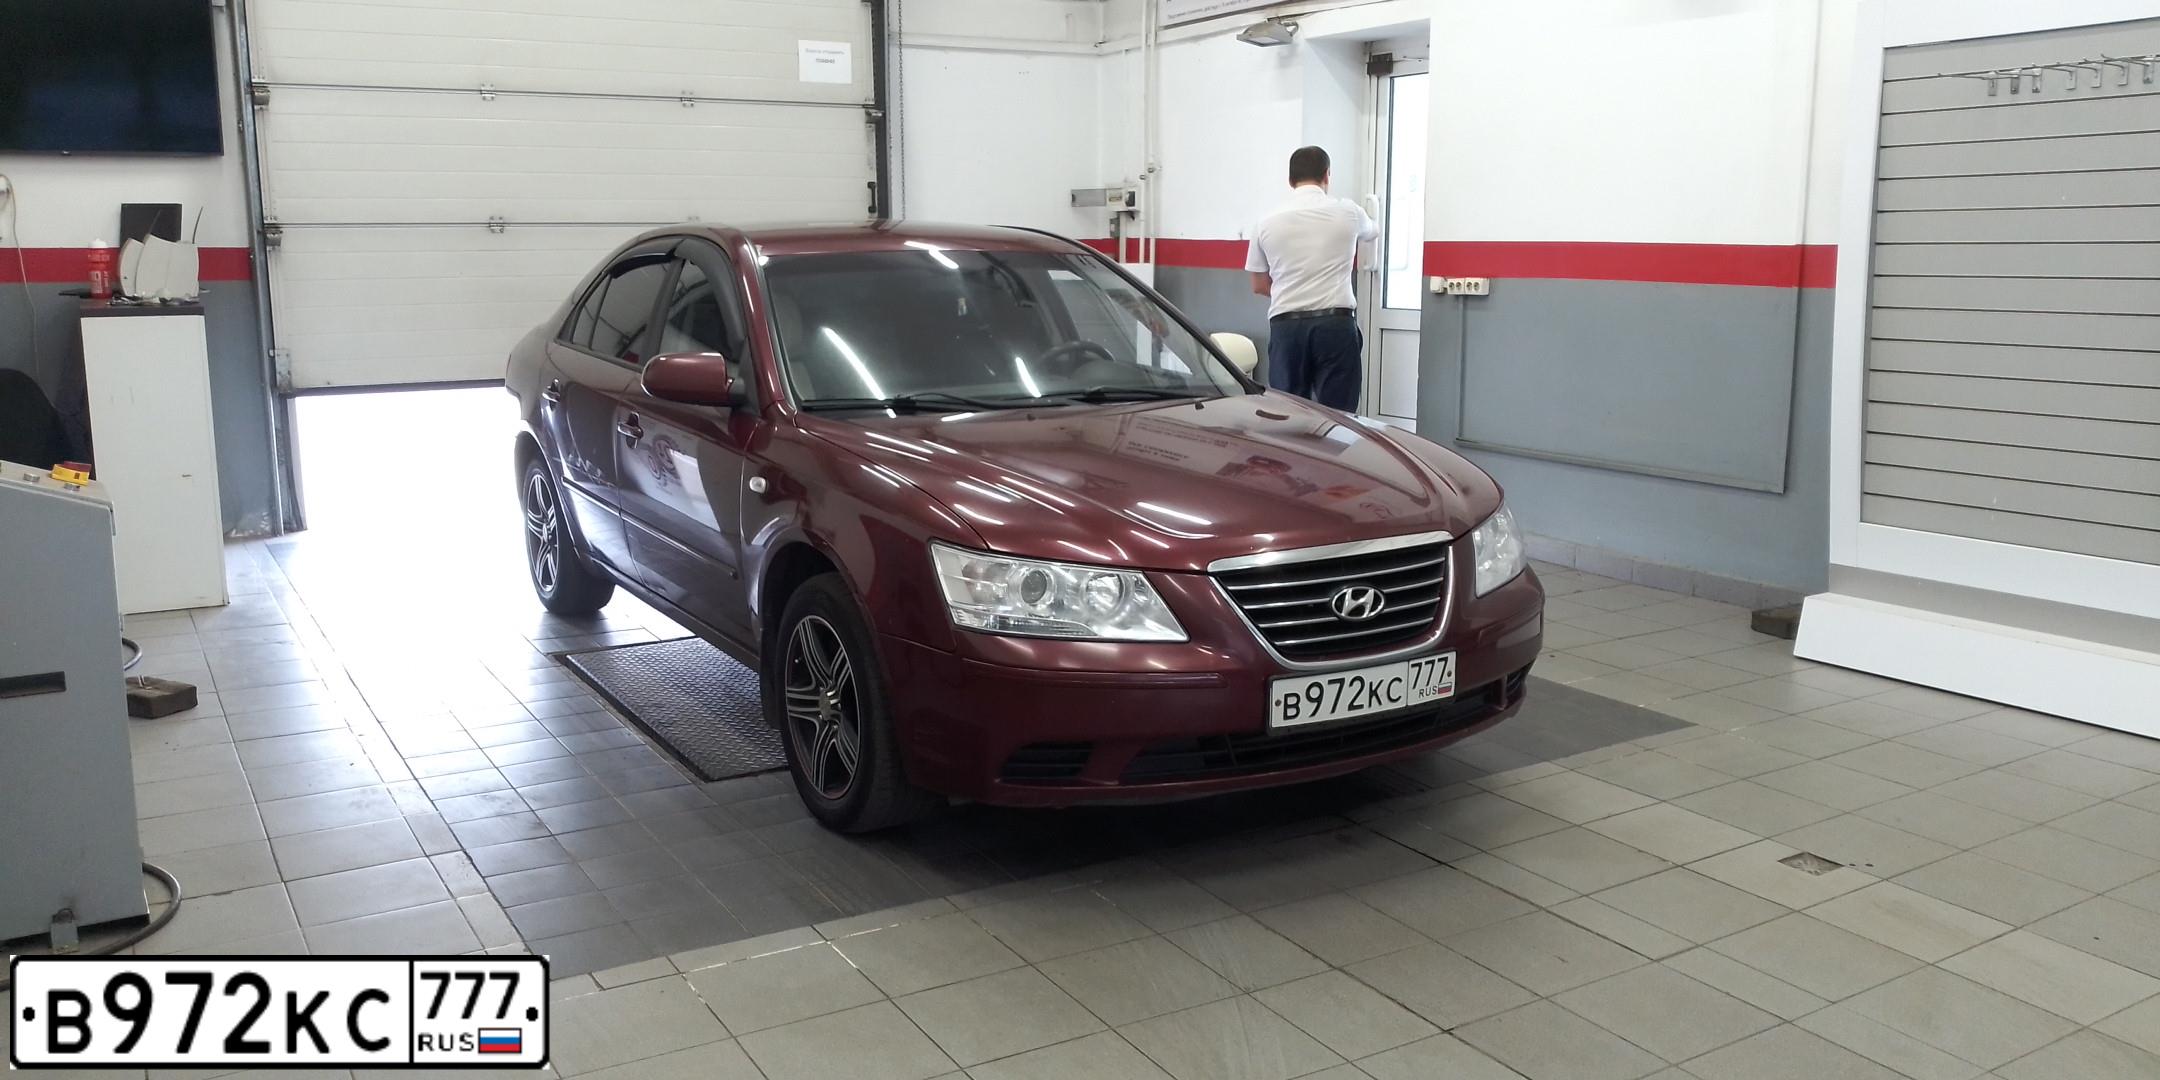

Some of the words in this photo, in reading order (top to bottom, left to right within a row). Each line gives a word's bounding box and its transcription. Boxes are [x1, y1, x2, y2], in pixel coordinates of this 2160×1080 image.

[1410, 657, 1449, 690] 777
[1282, 676, 1403, 721] В972КС
[1418, 685, 1438, 699] RUS
